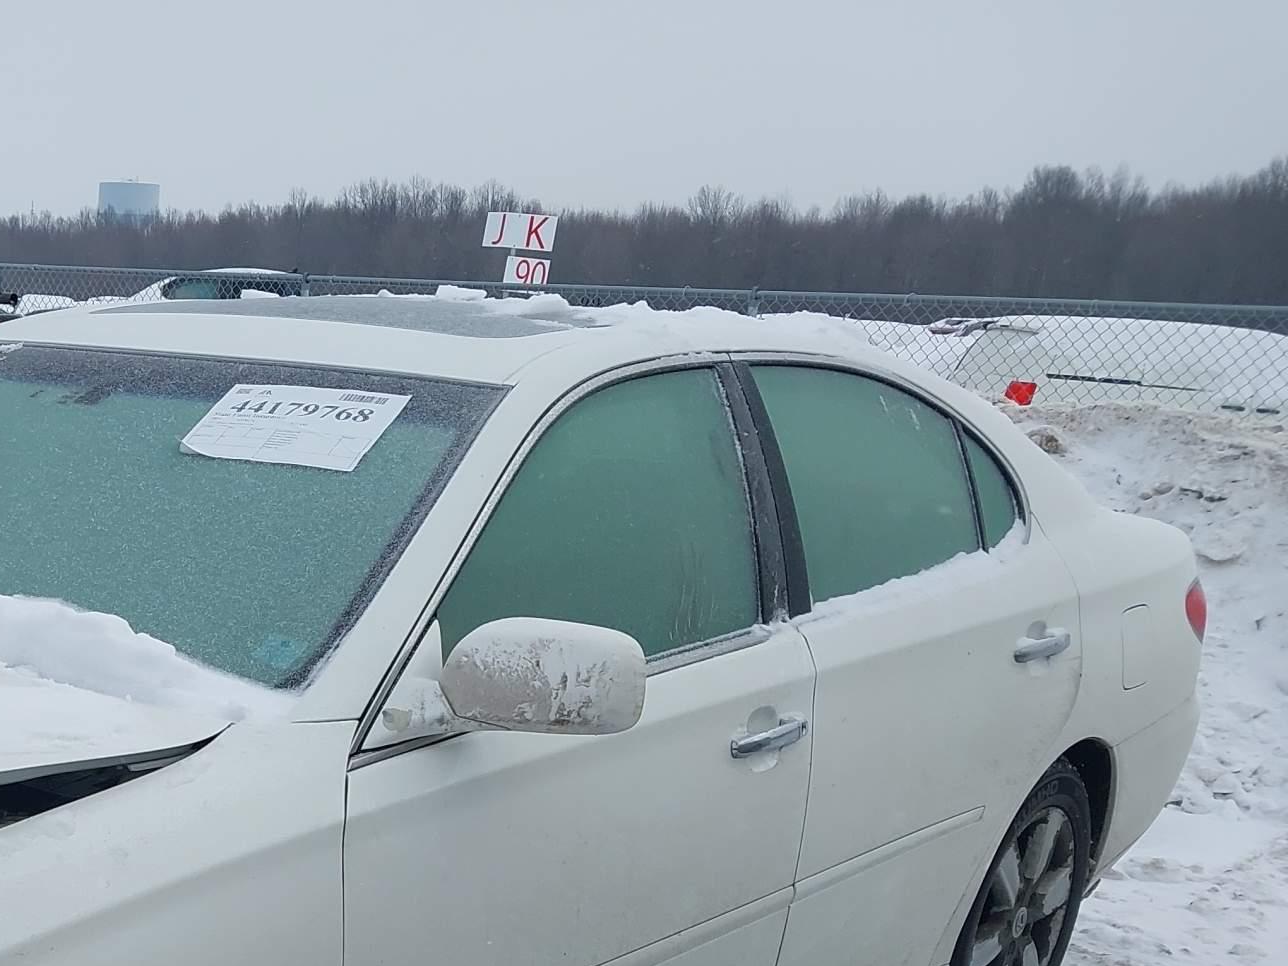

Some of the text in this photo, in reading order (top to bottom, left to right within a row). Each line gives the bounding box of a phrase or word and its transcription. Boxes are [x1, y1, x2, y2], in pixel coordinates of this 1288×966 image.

[491, 213, 550, 250] J K
[515, 259, 547, 285] 90
[230, 399, 375, 423] 44179768
